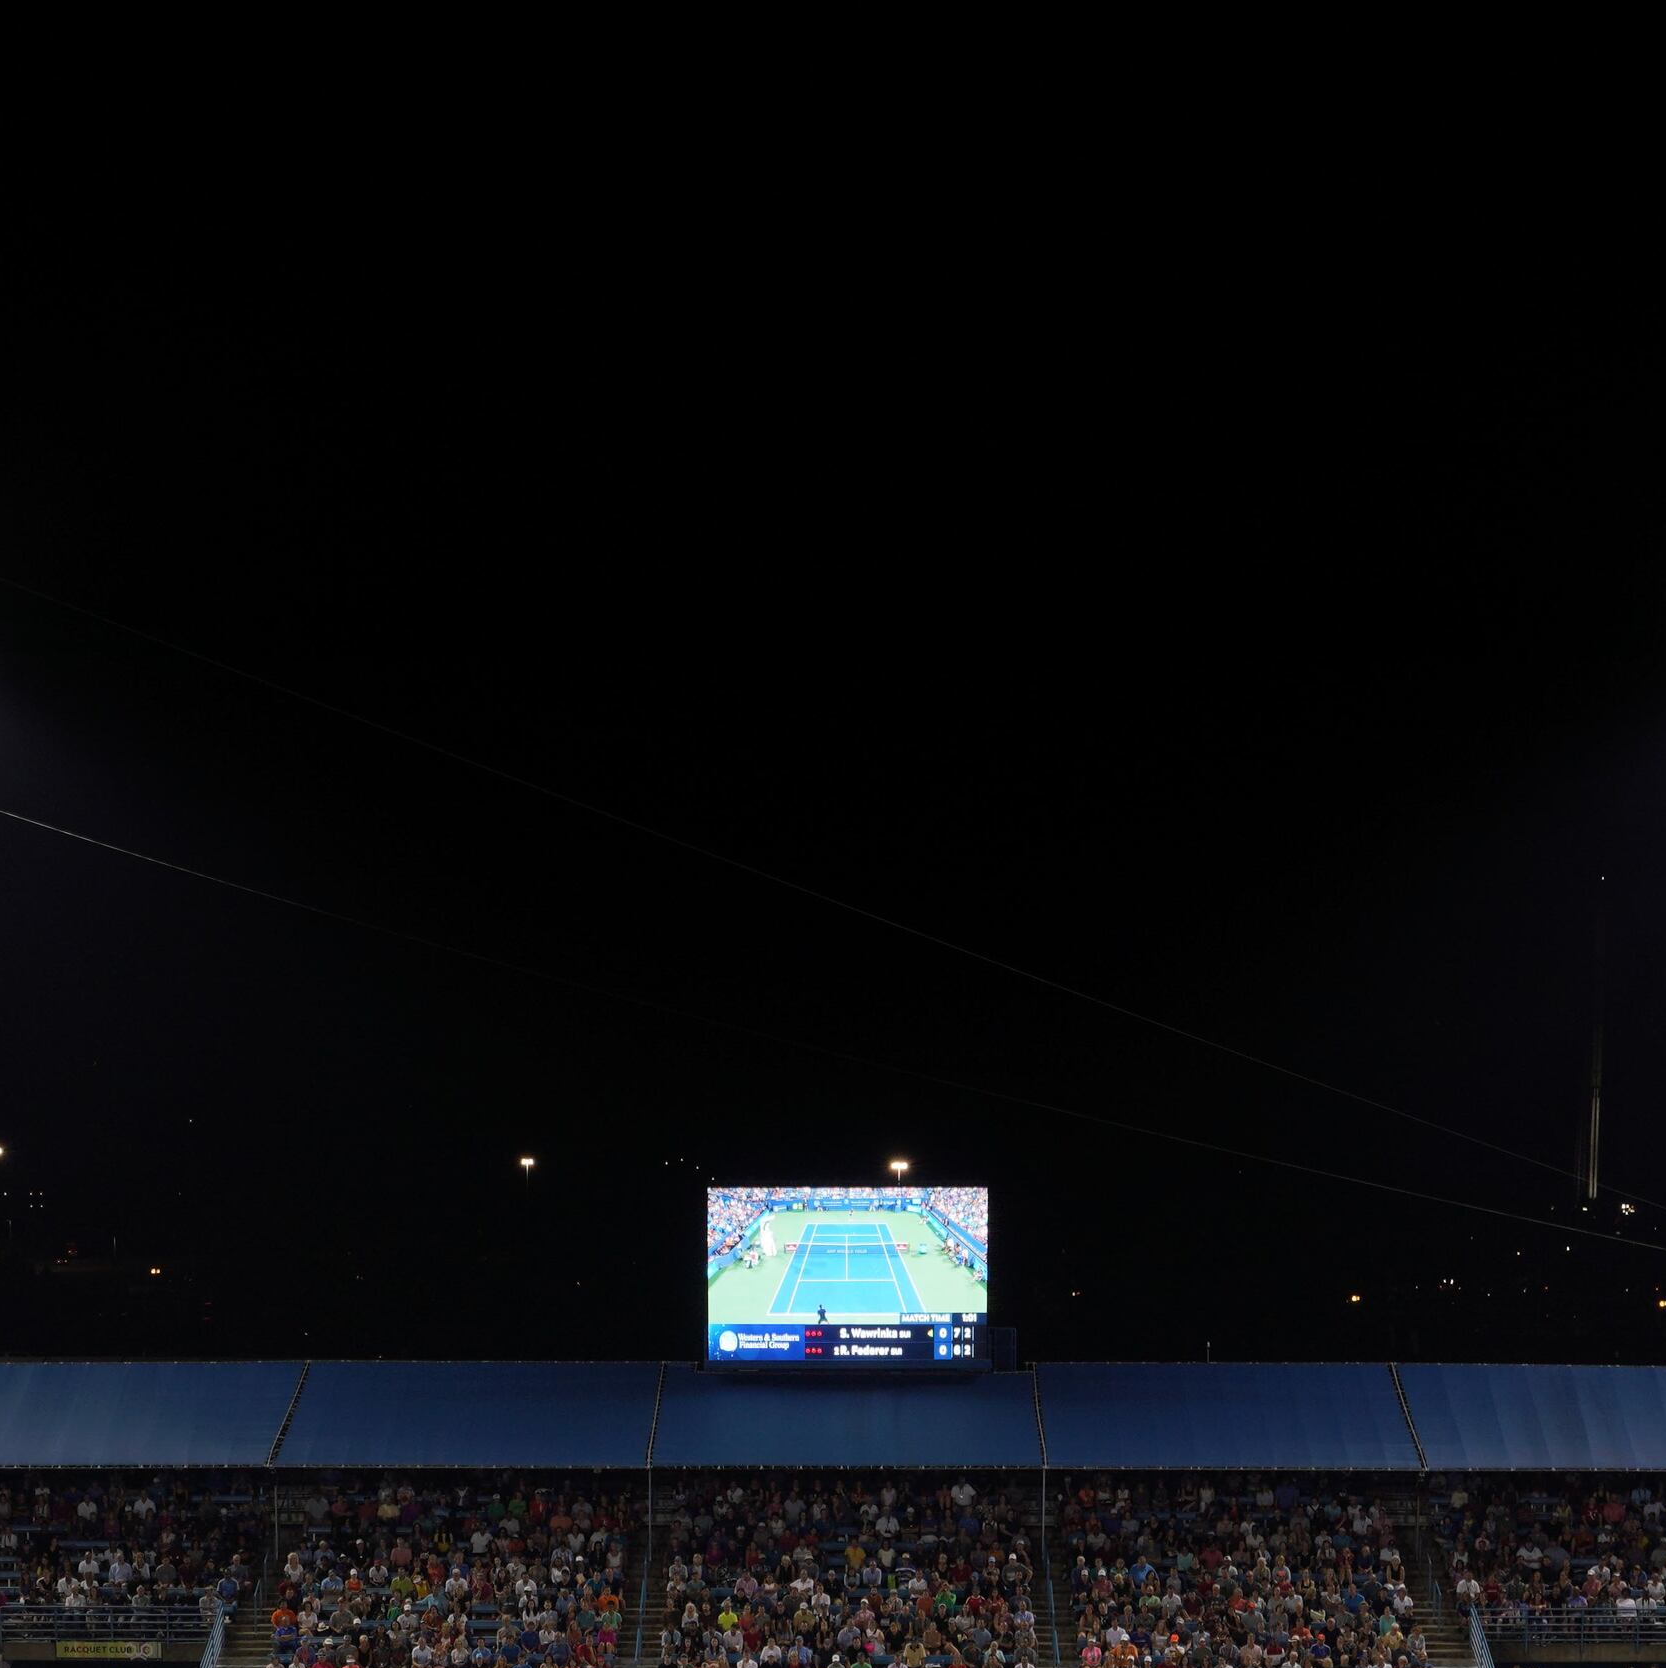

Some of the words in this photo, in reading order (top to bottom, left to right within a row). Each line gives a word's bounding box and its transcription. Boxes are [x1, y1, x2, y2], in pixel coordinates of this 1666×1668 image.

[901, 1314, 930, 1322] MATCH
[931, 1314, 950, 1322] TIME
[962, 1313, 977, 1322] 1:01
[839, 1327, 850, 1339] S.
[851, 1327, 898, 1339] Wawrinka
[953, 1327, 961, 1338] 7
[964, 1327, 971, 1338] 2
[851, 1345, 889, 1355] Federer
[964, 1344, 971, 1355] 2
